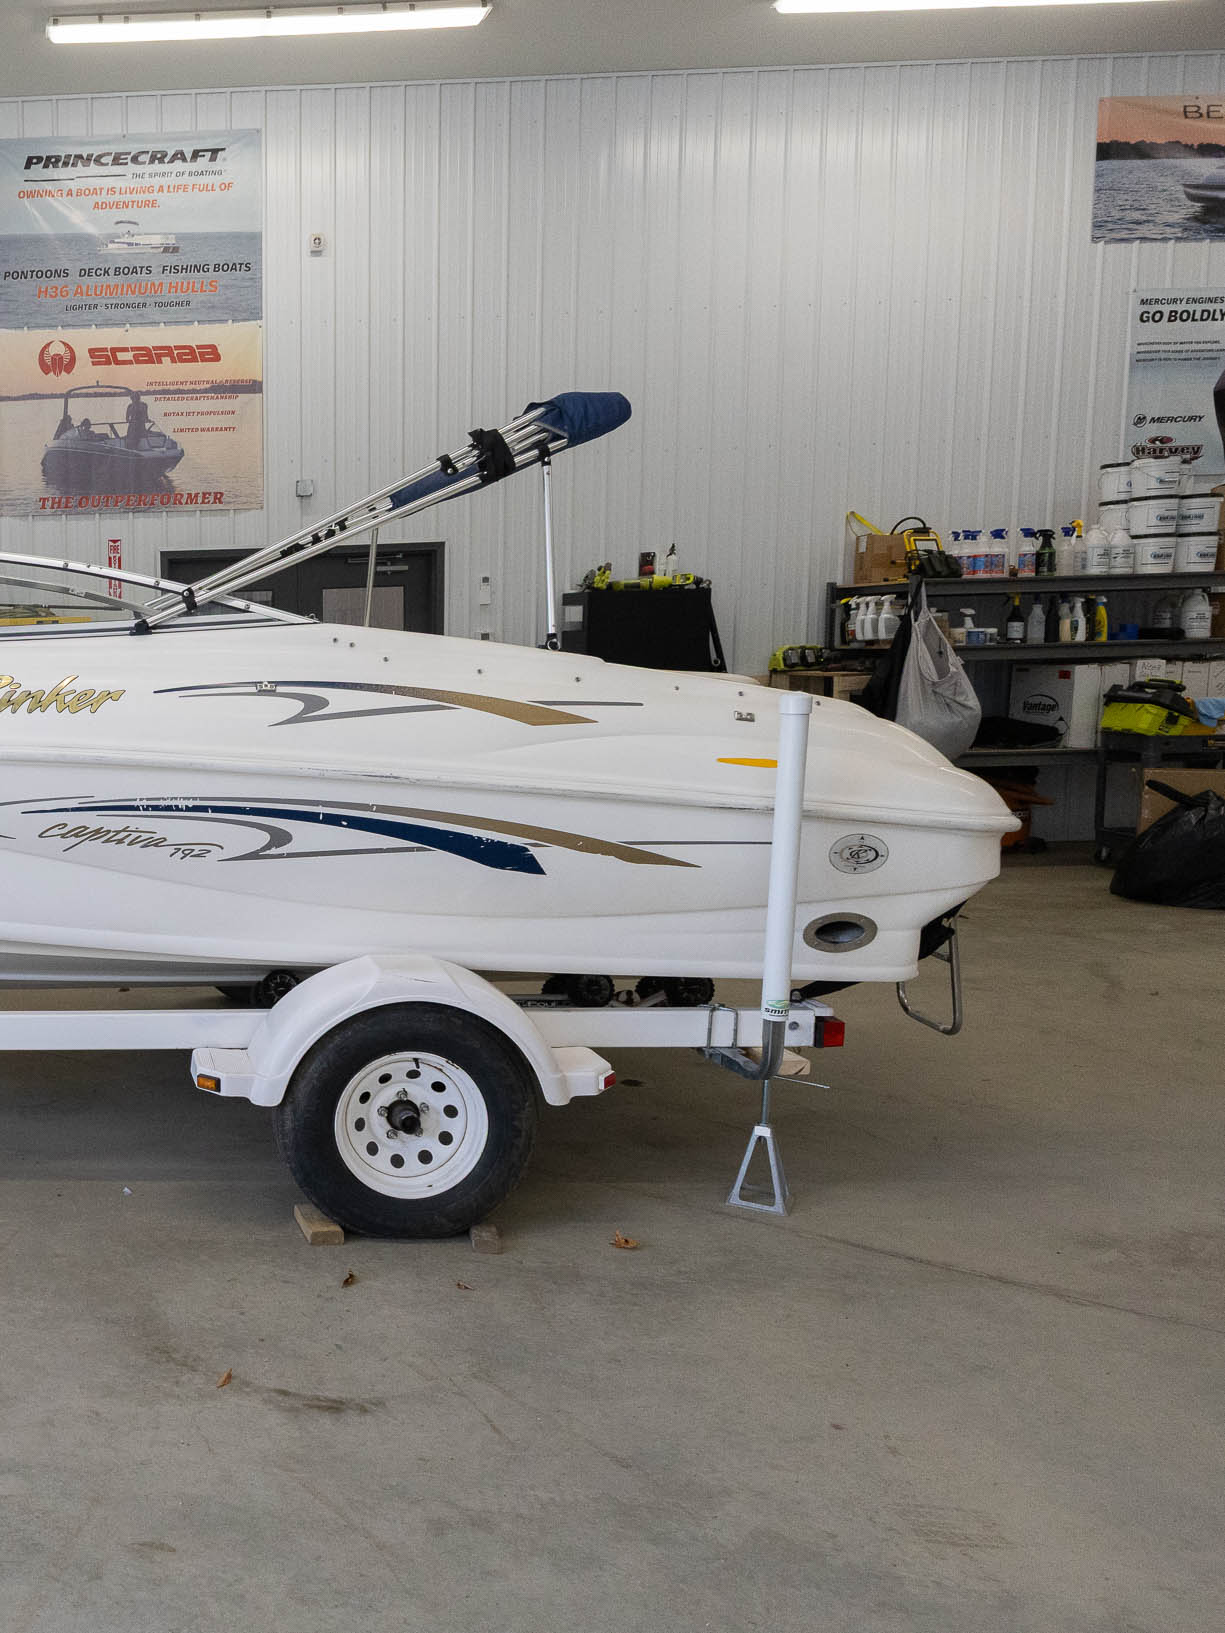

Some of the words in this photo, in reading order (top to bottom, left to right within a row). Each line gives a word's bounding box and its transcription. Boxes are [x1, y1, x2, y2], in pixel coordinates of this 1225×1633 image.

[24, 147, 226, 170] PRINCECRAFT
[131, 172, 146, 180] THE
[148, 171, 173, 179] SPIRIT
[175, 170, 186, 178] OF
[188, 169, 223, 177] BOATING
[17, 188, 64, 200] OWNING
[65, 187, 73, 198] A
[76, 186, 104, 198] BOAT
[106, 186, 117, 196] IS
[119, 185, 155, 196] LIVING
[156, 184, 164, 194] A
[167, 184, 189, 194] LIFE
[191, 182, 216, 193] FULL
[218, 182, 234, 191] OF
[92, 199, 161, 211] ADVENTURE.
[3, 268, 70, 281] PONTOONS
[78, 267, 111, 278] DECK
[113, 265, 153, 277] BOATS
[161, 264, 210, 275] FISHING
[213, 262, 252, 274] BOATS
[36, 284, 69, 299] H36
[73, 281, 163, 298] ALUMINUM
[167, 280, 219, 294] HULLS
[65, 303, 99, 312] LIGHTER
[104, 301, 147, 311] STRONGER
[154, 300, 191, 308] TOUGHER
[1139, 297, 1184, 306] MERCURY
[1185, 296, 1225, 305] ENGINES
[1139, 310, 1164, 323] GO
[1167, 308, 1225, 323] BOLDLY
[87, 344, 222, 366] SCARAB
[1148, 415, 1205, 424] MERCURY
[1133, 444, 1202, 459] Harvey
[38, 496, 74, 510] THE
[77, 491, 225, 509] OUTPERFORMER
